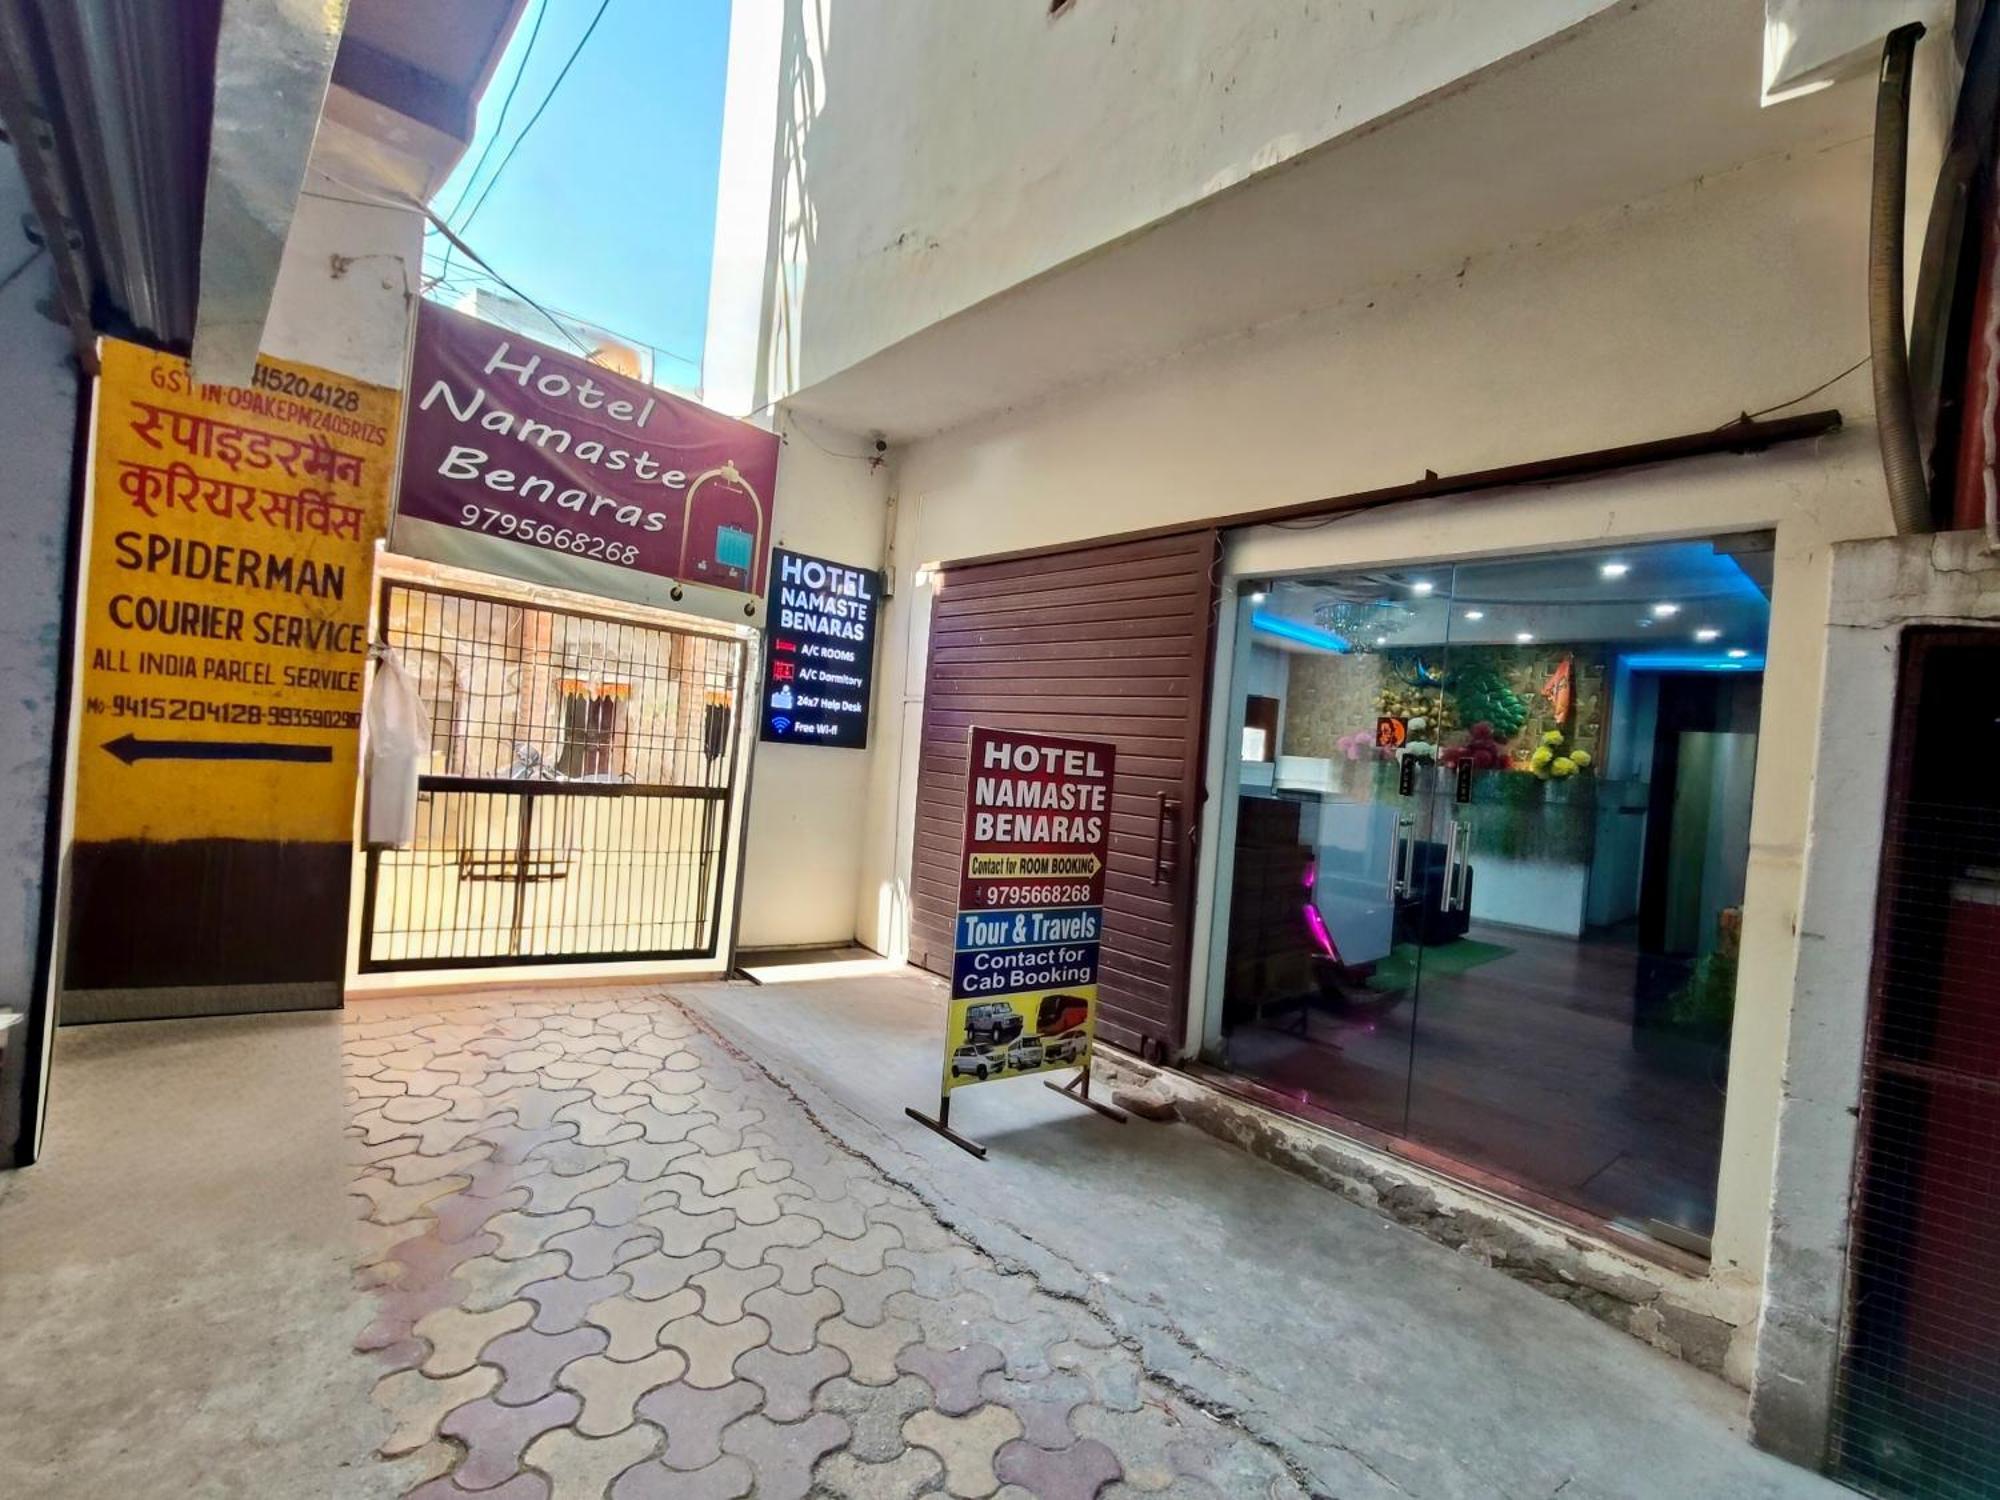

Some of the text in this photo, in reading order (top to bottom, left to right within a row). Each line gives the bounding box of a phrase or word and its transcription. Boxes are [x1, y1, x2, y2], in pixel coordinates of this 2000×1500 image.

[484, 342, 656, 428] Hotel
[419, 380, 686, 489] Namaste
[438, 445, 668, 532] Benaras
[459, 503, 640, 565] 9795668268
[115, 530, 346, 600] SPIDERMAN
[781, 554, 871, 600] HOTEL
[781, 587, 868, 621] NAMASTE
[108, 594, 366, 654] COURIER SERVICE
[780, 609, 865, 641] BENARAS
[801, 643, 855, 662] A/C ROOMS
[92, 648, 360, 692] ALL INDIA PARCEL SERVICE
[799, 667, 863, 688] A/C Dormitory
[820, 698, 840, 712] Help
[841, 699, 862, 713] Desk
[794, 721, 815, 734] Free
[984, 741, 1104, 777] HOTEL
[975, 777, 1106, 812] NAMASTE
[974, 812, 1102, 844] BENARAS
[972, 856, 1094, 875] Contact for ROOM BOOKING
[987, 885, 1091, 905] 9795668268
[966, 911, 1096, 946] Tour & Travels
[974, 947, 1086, 971] Contact for
[963, 966, 1091, 991] Cab Booking
